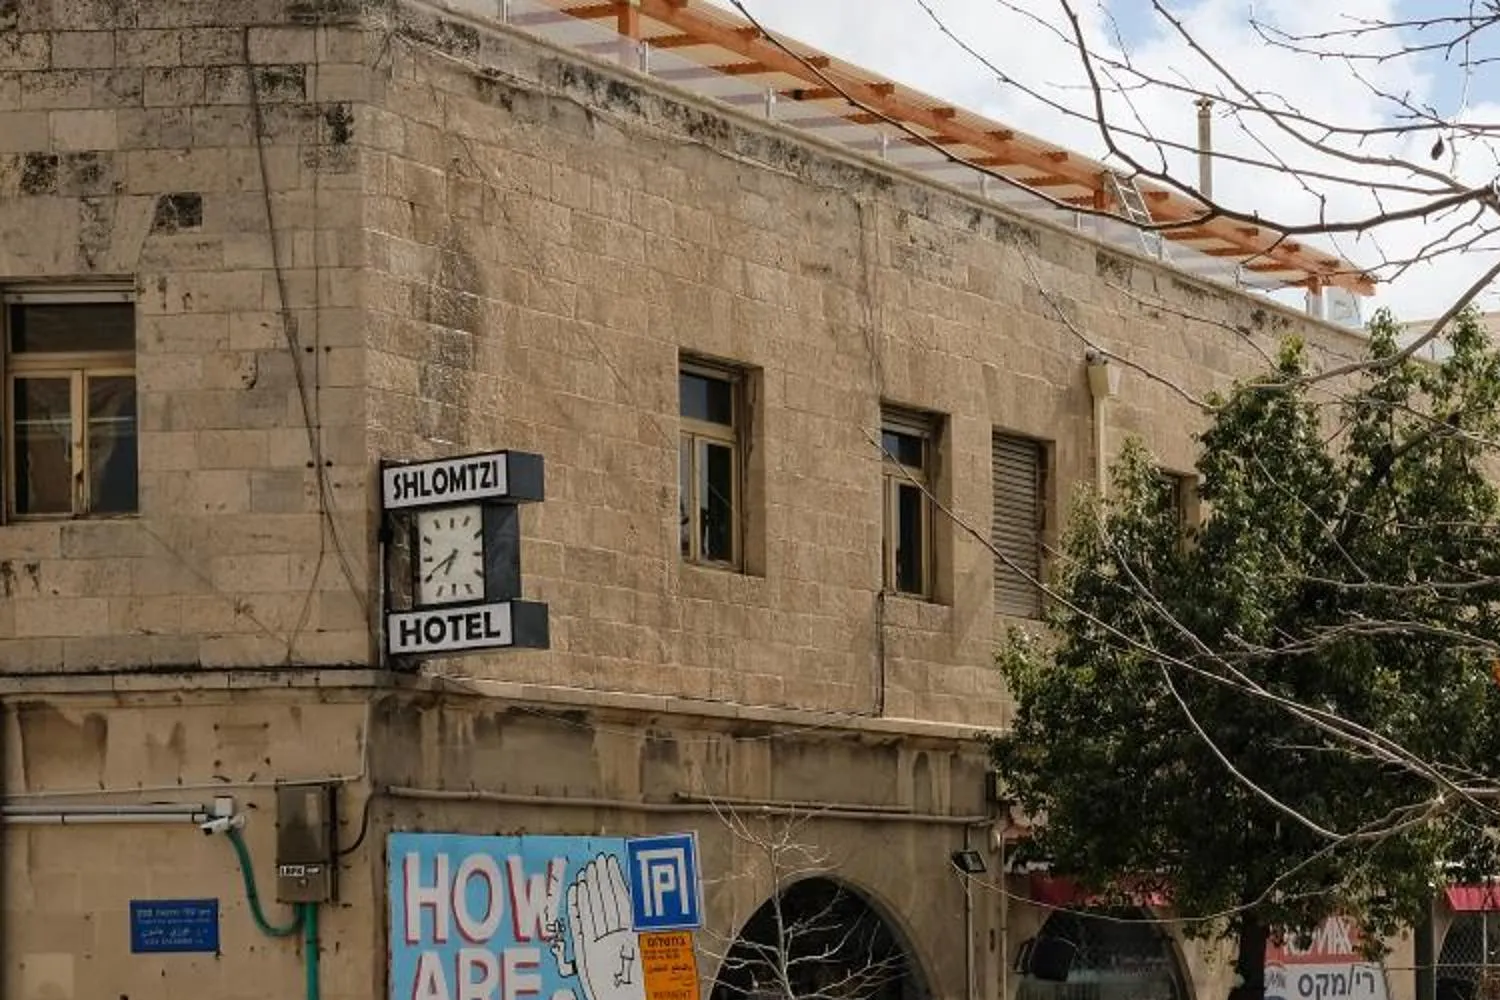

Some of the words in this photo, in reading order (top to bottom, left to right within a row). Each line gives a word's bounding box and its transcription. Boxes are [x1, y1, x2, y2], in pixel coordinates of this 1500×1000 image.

[393, 461, 499, 500] SHLOMTZI
[400, 612, 501, 646] HOTEL
[403, 852, 569, 945] HOW
